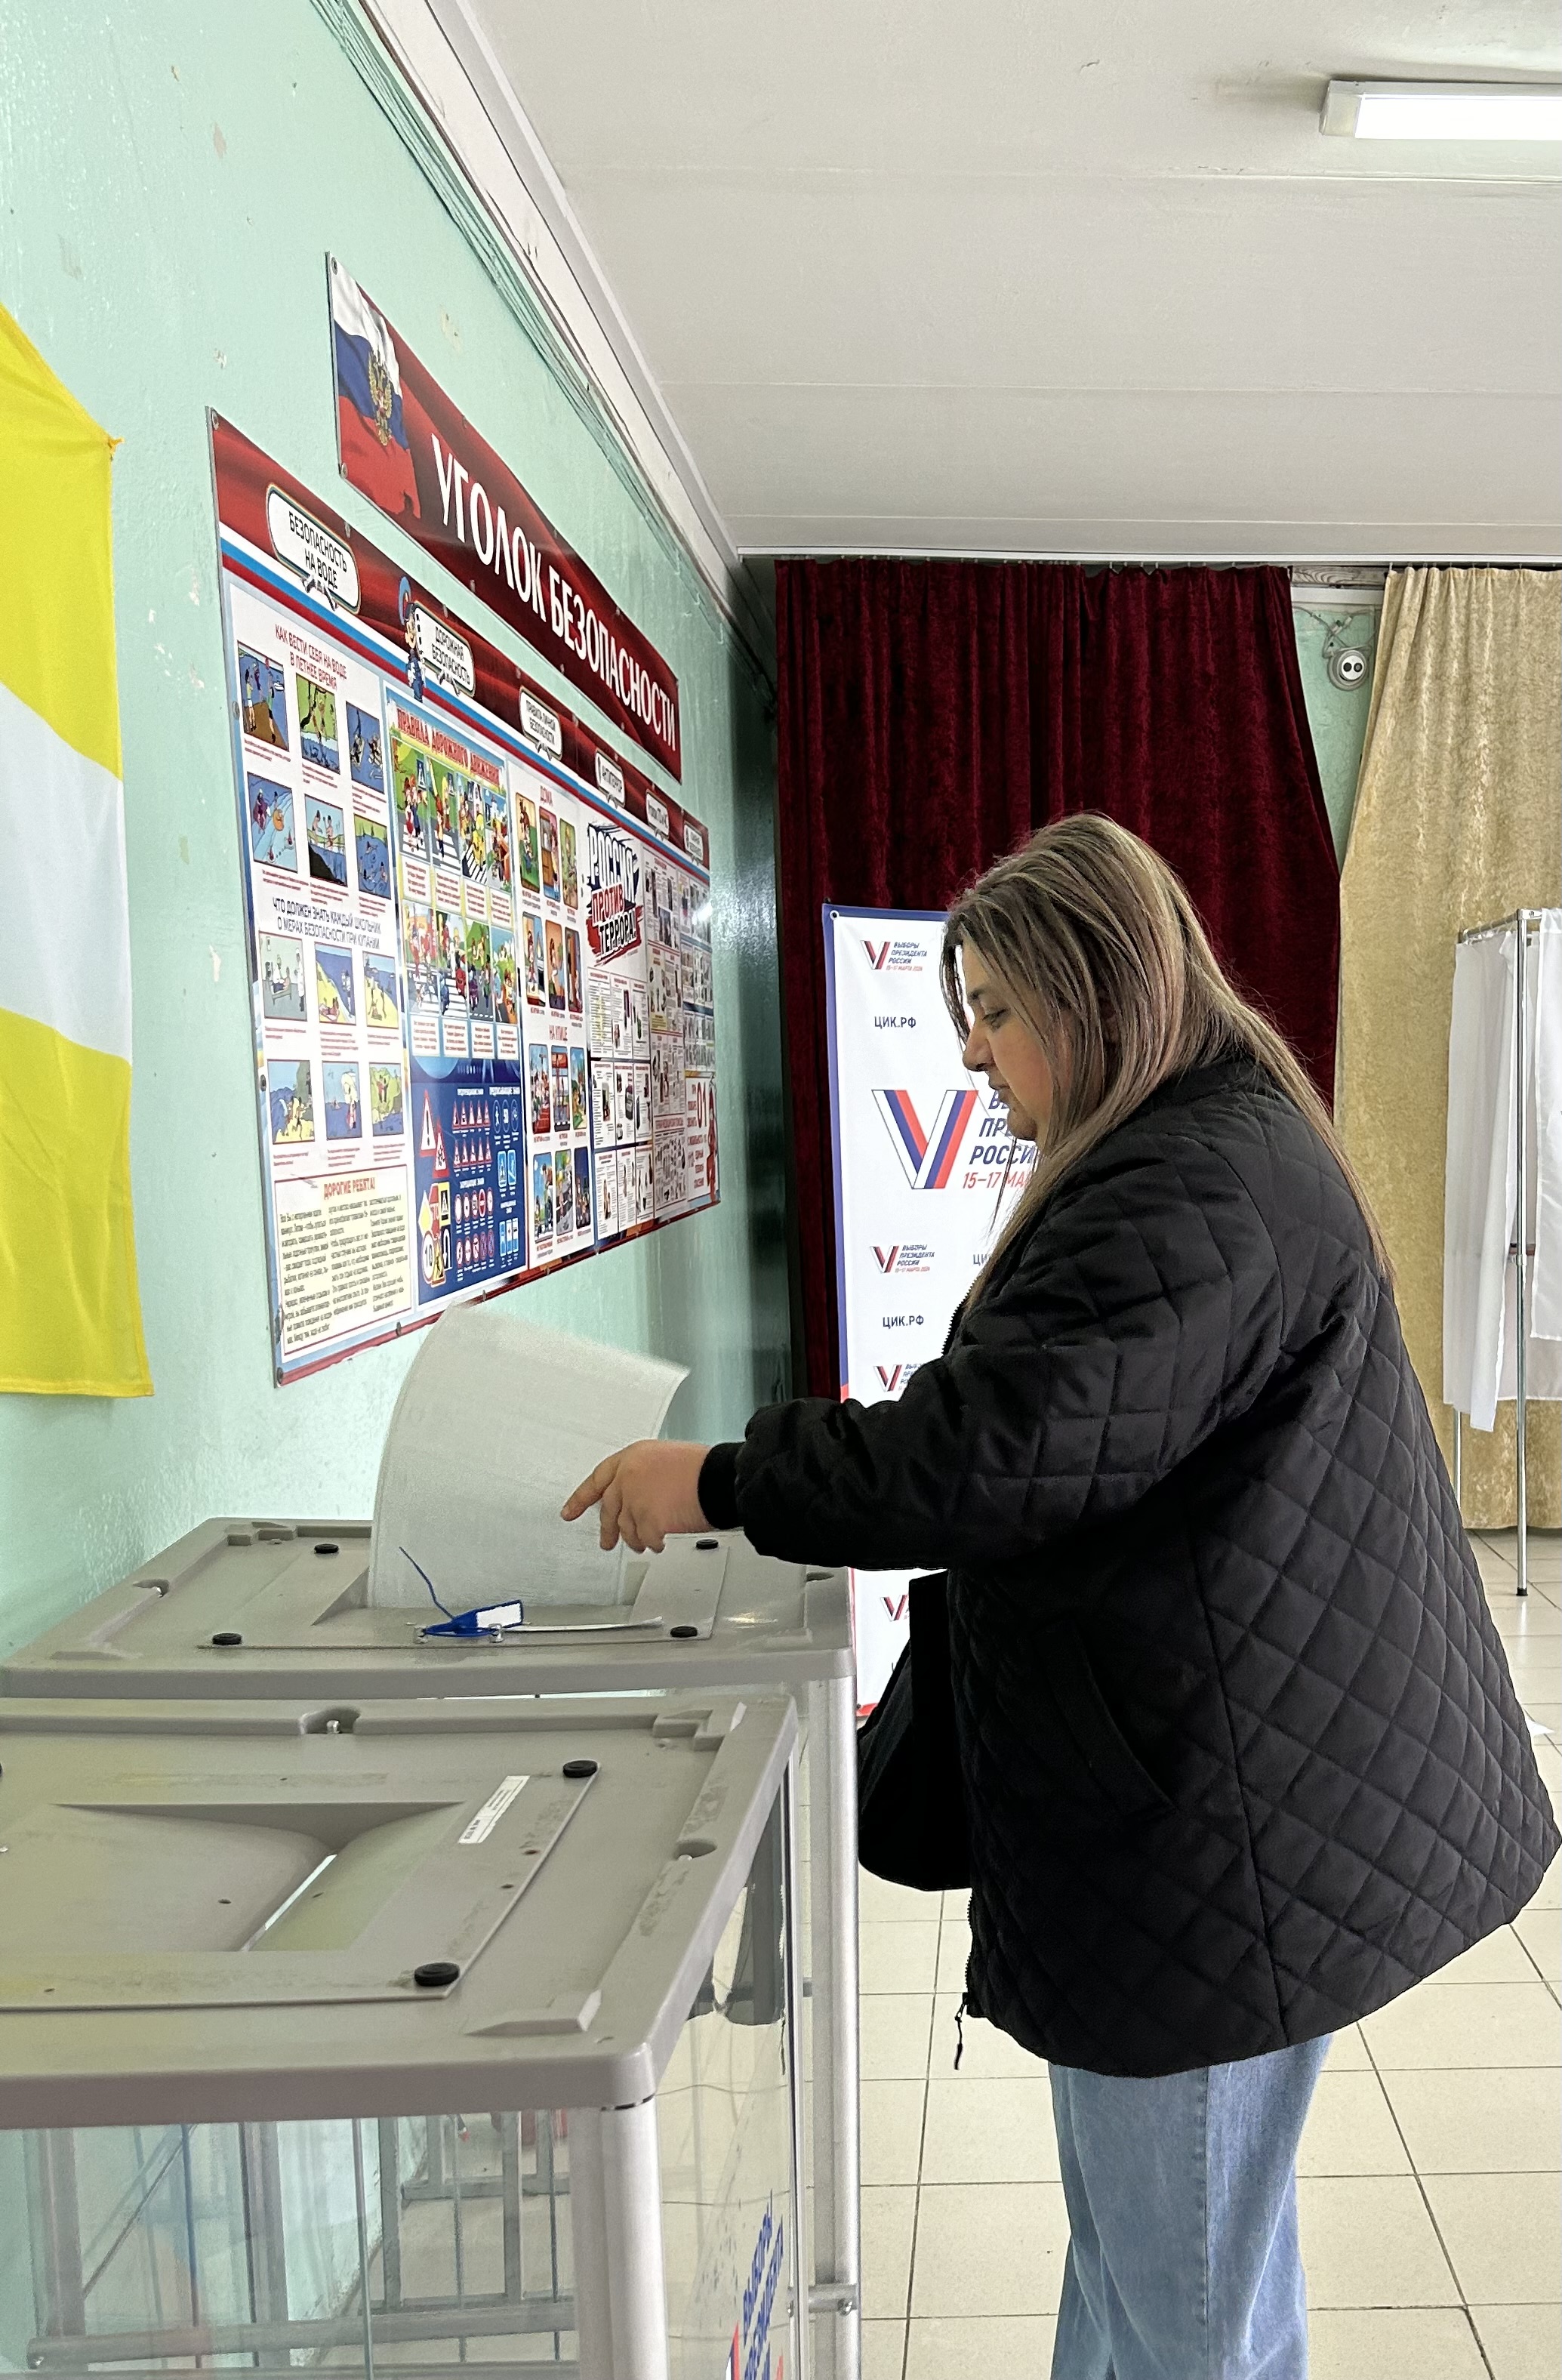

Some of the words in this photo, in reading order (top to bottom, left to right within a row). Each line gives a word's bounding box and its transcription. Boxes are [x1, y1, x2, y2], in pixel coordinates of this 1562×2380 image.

[288, 510, 347, 573] БЕЗОПАСНОСТЬ
[304, 547, 316, 574] НА
[316, 556, 338, 590] ВОДЕ
[431, 433, 547, 623] УГОЛОК
[549, 565, 676, 751] БЕЗОПАСНОСТИ
[275, 623, 289, 645] КАК
[288, 631, 308, 655] ВЕСТИ
[308, 643, 323, 665] СЕБЯ
[396, 707, 430, 748] ПРАВИЛА
[432, 727, 469, 769] ДОРОЖНОГО
[588, 824, 636, 905] РОССИЯ
[272, 896, 285, 914] ЧТО
[286, 900, 312, 919] ДОЛЖЕН
[592, 883, 624, 924] ПРОТИВ
[283, 917, 303, 934] МЕРАХ
[599, 908, 636, 954] ТЕРРОРА!
[874, 1016, 917, 1029] ЦИК.РФ
[969, 1145, 1037, 1165] РОССИ
[324, 1180, 352, 1200] ДОРОГИЕ
[882, 1315, 924, 1329] ЦИК.РФ
